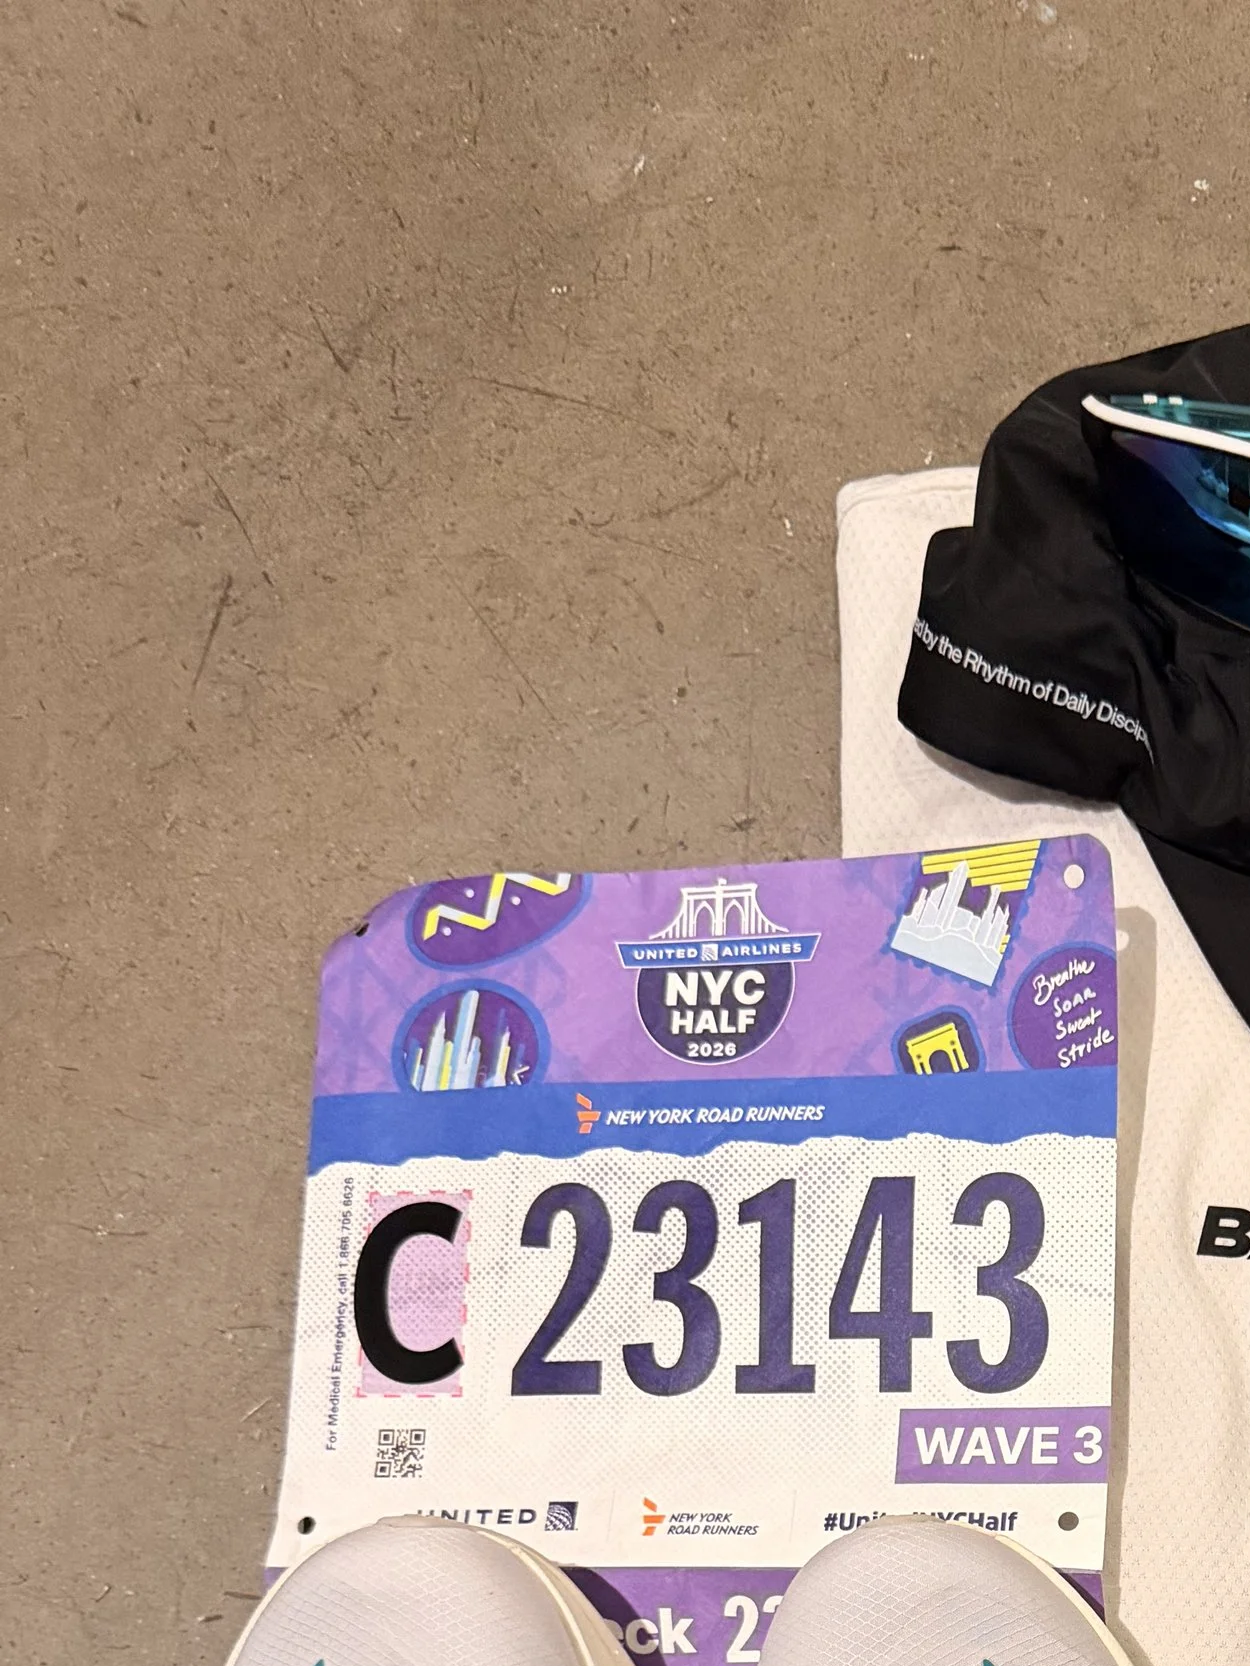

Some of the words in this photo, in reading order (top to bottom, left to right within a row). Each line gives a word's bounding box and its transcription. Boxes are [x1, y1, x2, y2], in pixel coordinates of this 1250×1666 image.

[922, 622, 939, 651] by
[938, 634, 963, 664] the
[963, 648, 1032, 695] Rhythm
[1032, 682, 1054, 702] of
[1052, 685, 1097, 720] Daily
[633, 948, 698, 961] UNITED
[721, 942, 802, 957] AIRLINES
[664, 969, 766, 1006] NYC
[1032, 958, 1095, 1006] Breathe
[671, 1008, 756, 1035] HALF
[1056, 1007, 1102, 1040] Sweat
[687, 1043, 737, 1058] 2026
[1058, 1026, 1115, 1068] Stride
[606, 1109, 648, 1126] NEW
[649, 1108, 696, 1125] YORK
[696, 1107, 746, 1124] ROAD
[745, 1105, 826, 1122] RUNNERS
[338, 1273, 348, 1295] call
[353, 1201, 464, 1384] C
[511, 1172, 1049, 1396] 23143
[328, 1376, 341, 1426] Medical
[326, 1431, 337, 1451] For
[914, 1427, 1059, 1465] WAVE
[1073, 1425, 1103, 1465] 3
[667, 1525, 701, 1535] ROAD
[702, 1525, 759, 1535] RUNNERS
[669, 1513, 698, 1523] NEW
[699, 1513, 733, 1523] YORK
[723, 1595, 786, 1663] 2
